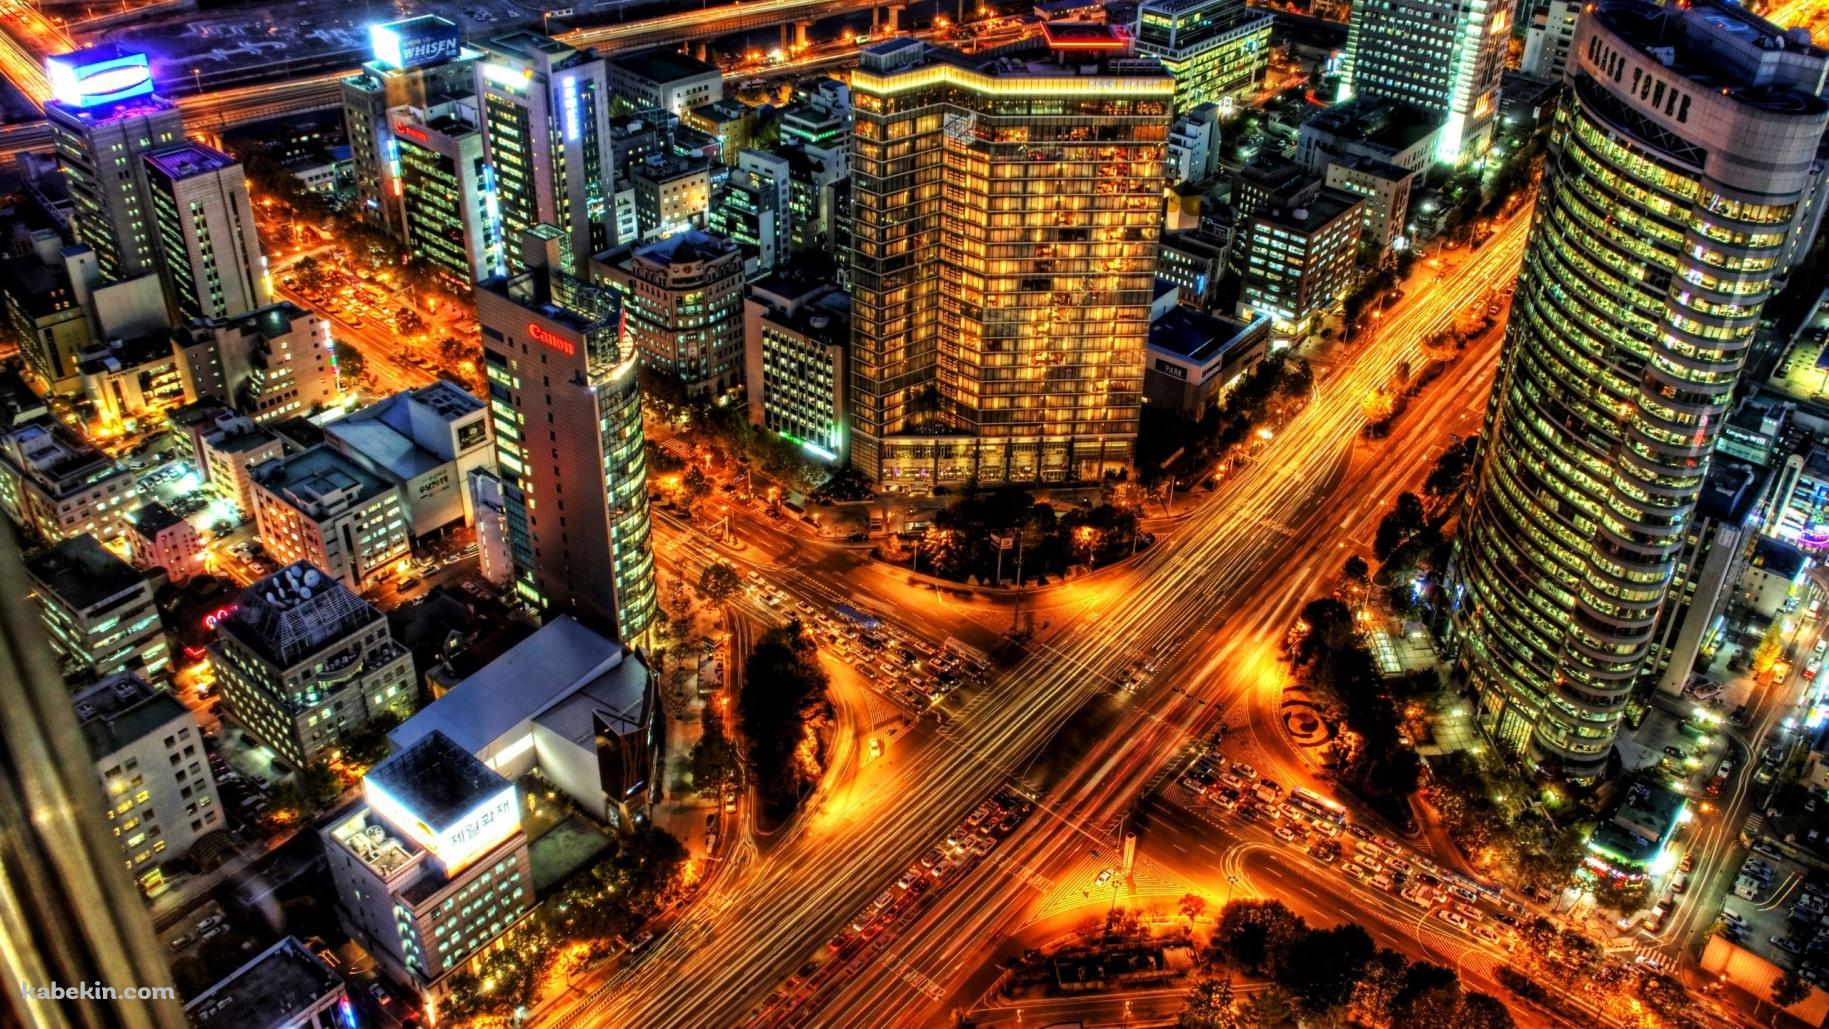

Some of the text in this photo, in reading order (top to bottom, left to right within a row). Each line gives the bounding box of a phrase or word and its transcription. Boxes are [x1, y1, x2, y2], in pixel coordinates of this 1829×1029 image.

[403, 37, 457, 59] WHISEN
[1588, 35, 1692, 123] GLASS TOWER
[528, 323, 574, 356] Canon
